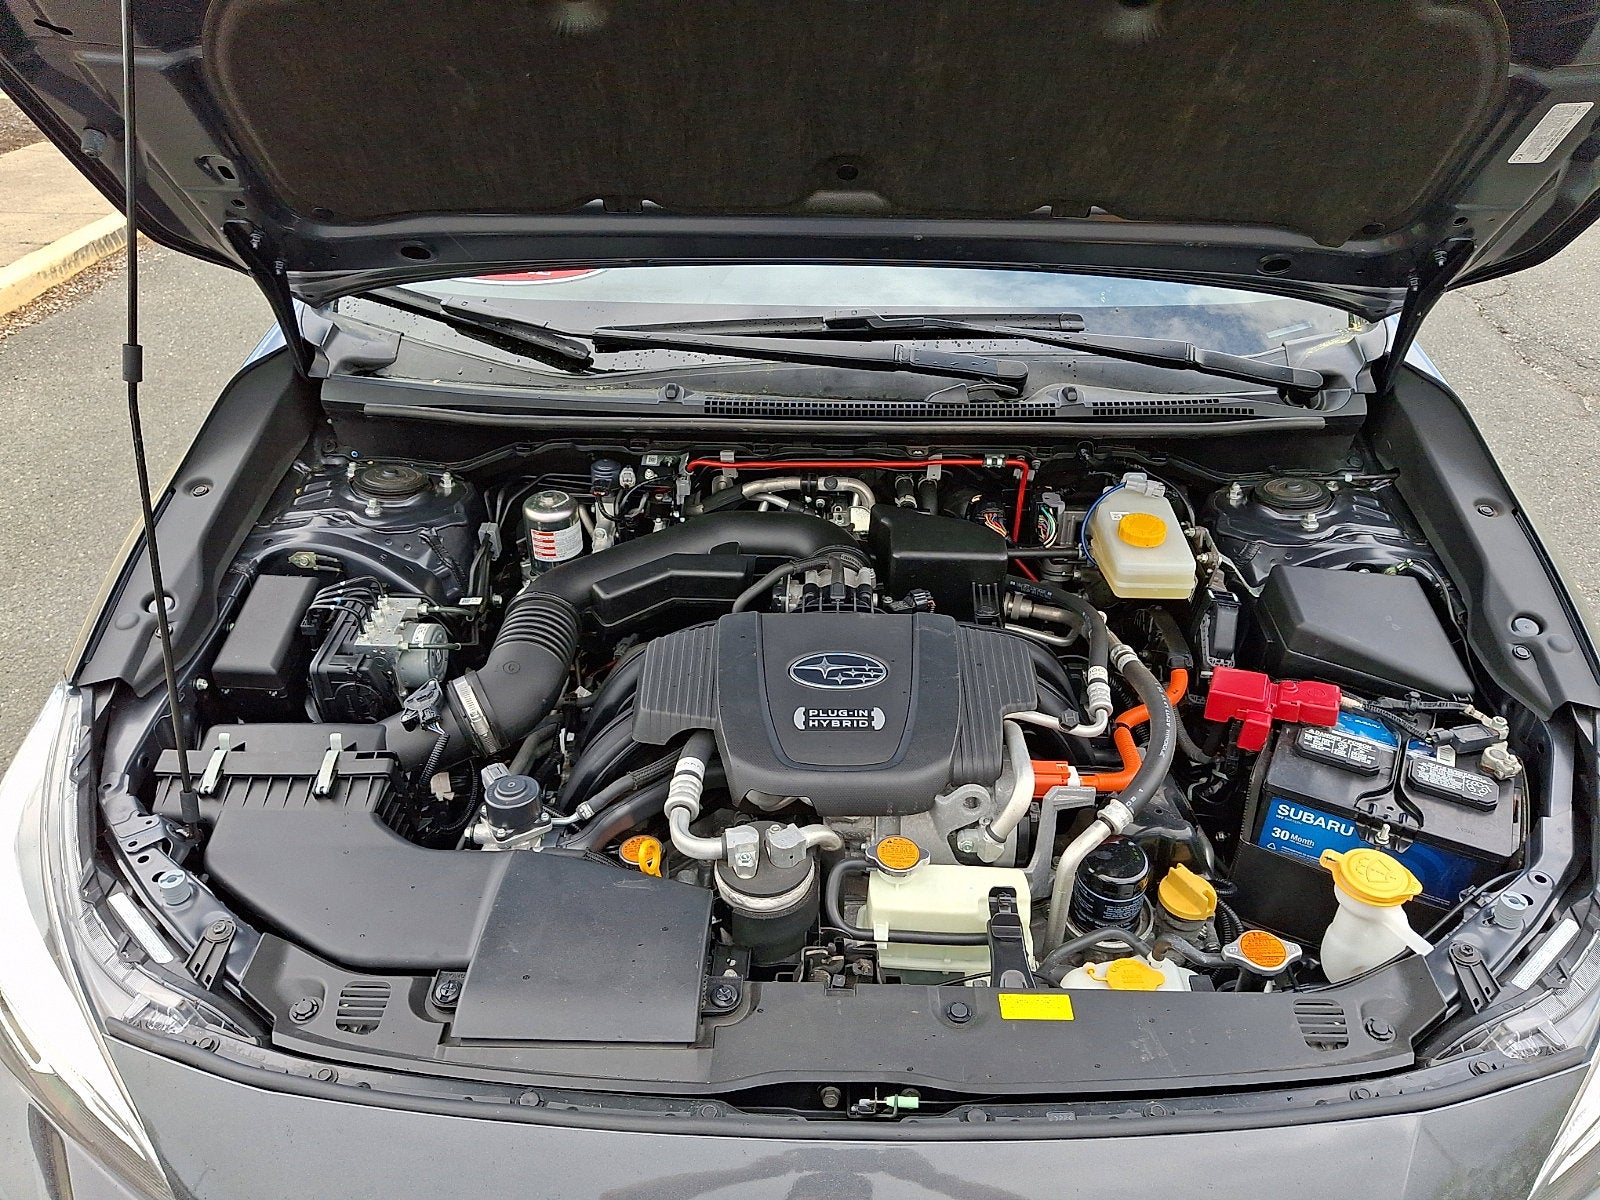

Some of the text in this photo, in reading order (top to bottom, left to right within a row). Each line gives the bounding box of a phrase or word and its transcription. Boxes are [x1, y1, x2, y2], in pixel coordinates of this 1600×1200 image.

[809, 709, 868, 717] PLUG-IN
[1277, 804, 1354, 837] SUBARU
[1271, 827, 1289, 841] 30
[1290, 833, 1315, 847] Month
